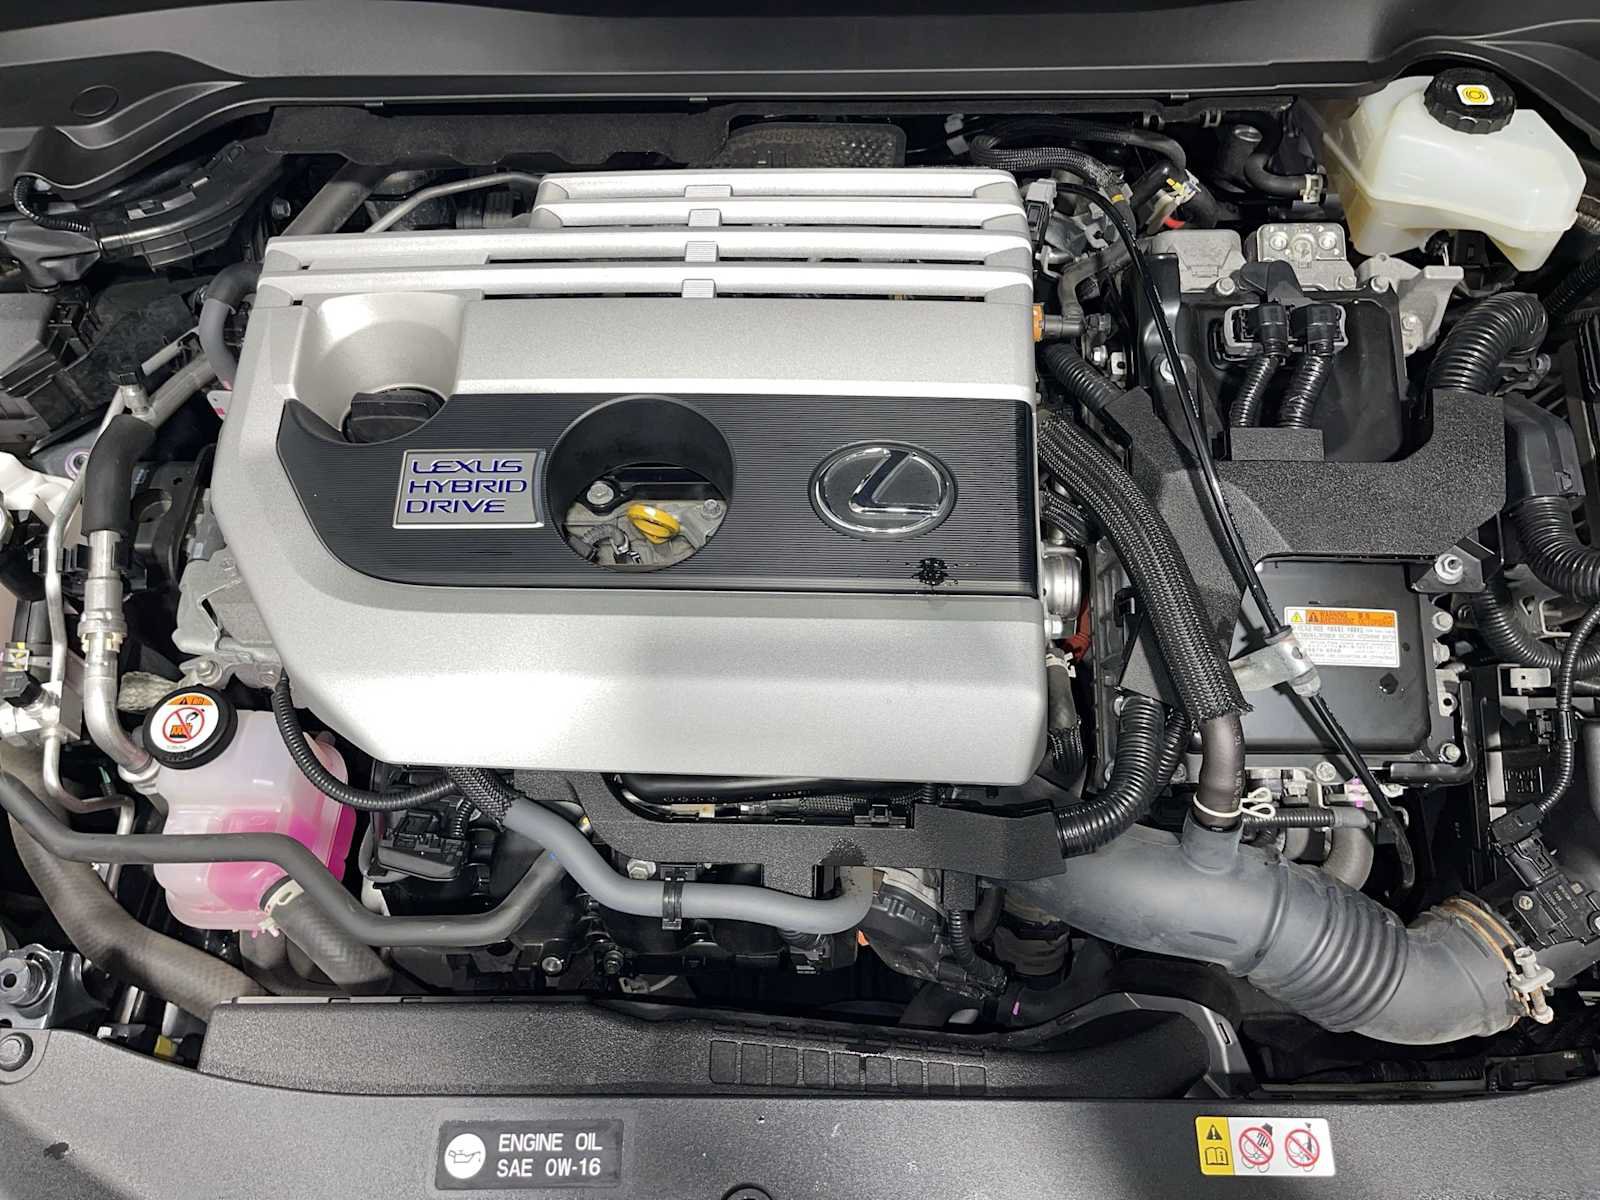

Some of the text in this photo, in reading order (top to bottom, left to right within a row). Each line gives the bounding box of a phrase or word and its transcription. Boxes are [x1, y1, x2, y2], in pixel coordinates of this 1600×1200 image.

[411, 459, 524, 474] LEXUS
[408, 479, 528, 494] HYBRID
[405, 499, 506, 514] DRIVE
[498, 1132, 603, 1152] ENGINE OIL
[496, 1157, 601, 1177] SAE 0W-16
